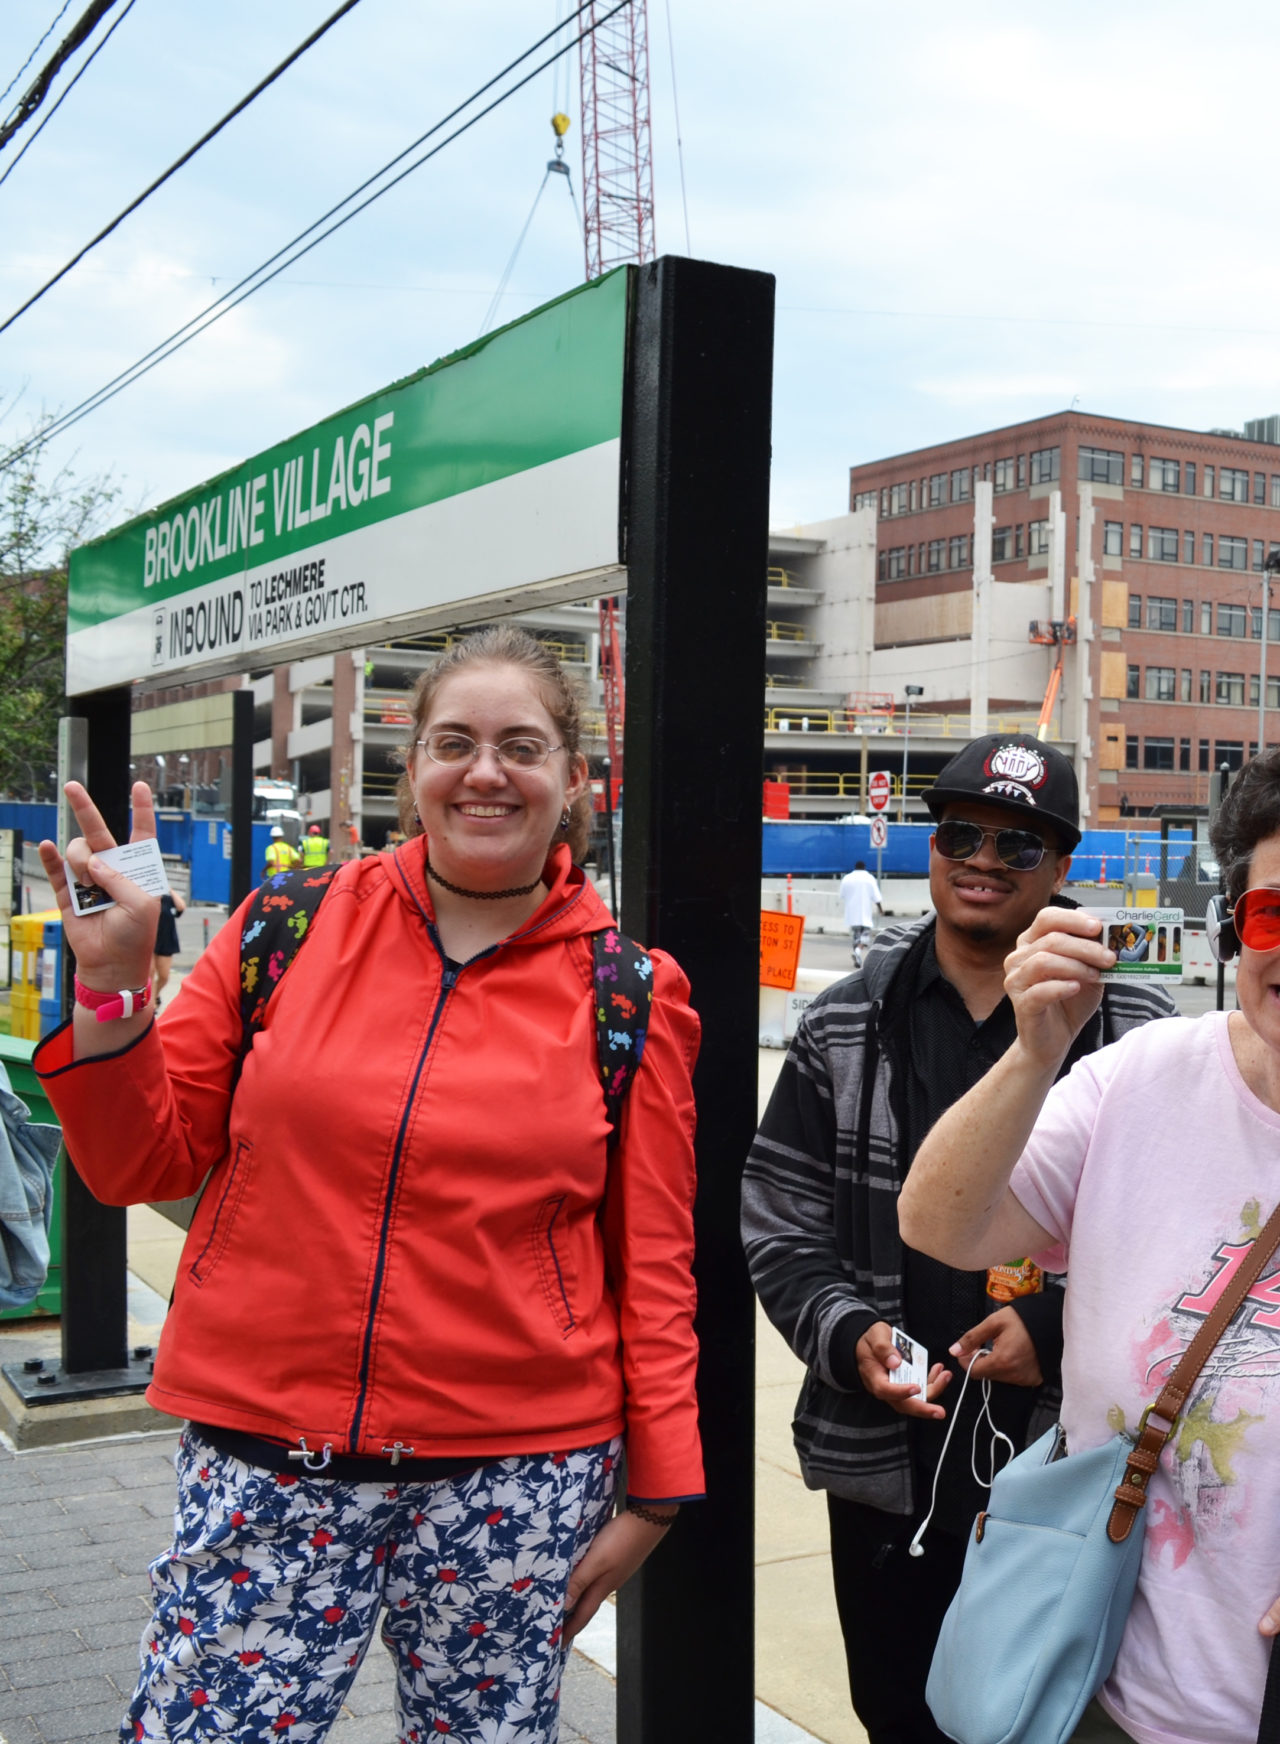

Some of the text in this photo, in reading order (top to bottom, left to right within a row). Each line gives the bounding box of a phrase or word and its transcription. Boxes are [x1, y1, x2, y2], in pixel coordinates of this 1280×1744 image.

[143, 411, 394, 588] BROOKLINE VILLAGE
[250, 558, 326, 610] TO LECHMERE
[169, 590, 244, 659] INBOUND
[249, 581, 368, 642] VIA PARK & GOV'T CTR.
[761, 921, 794, 935] ESS TO
[1116, 910, 1180, 921] CharlieCard
[761, 936, 779, 947] TON
[791, 998, 810, 1010] SID
